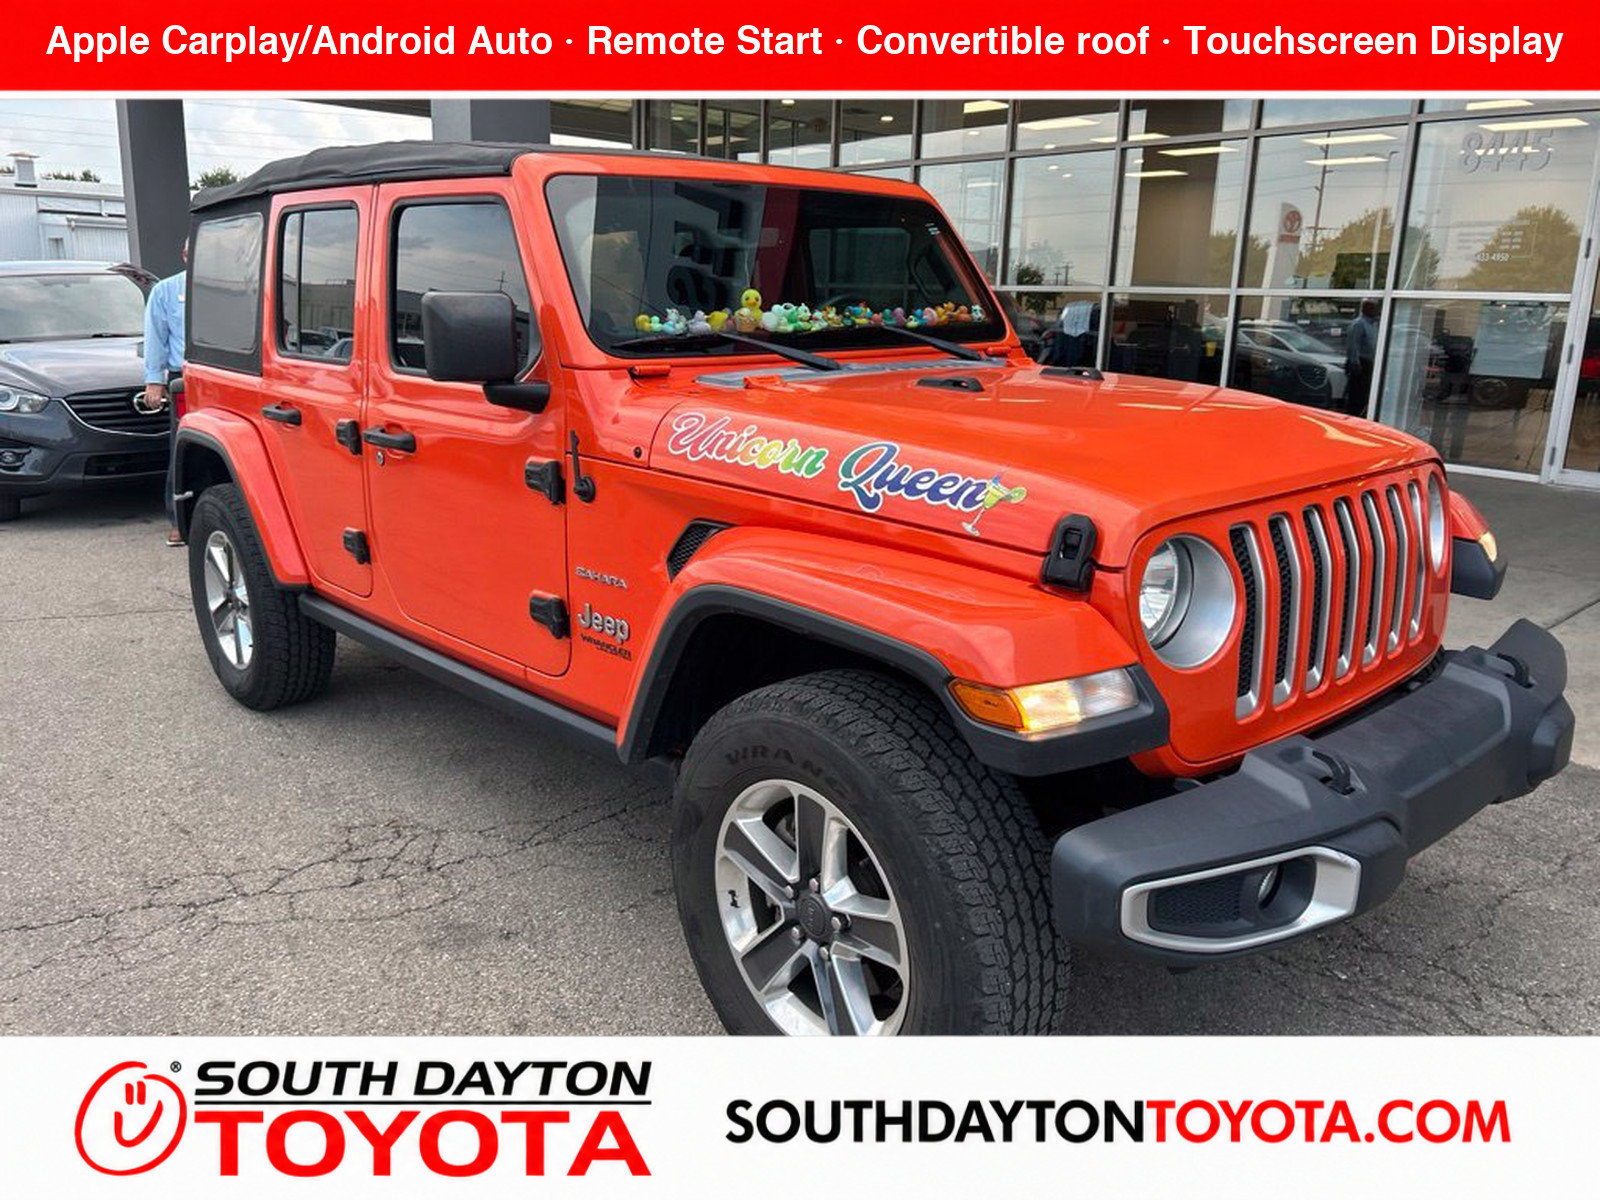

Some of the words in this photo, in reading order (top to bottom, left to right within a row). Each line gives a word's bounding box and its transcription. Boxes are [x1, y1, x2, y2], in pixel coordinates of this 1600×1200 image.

[1463, 129, 1554, 173] 8445
[668, 412, 829, 479] Unicorn
[838, 440, 988, 513] Queen
[575, 566, 627, 589] SAHARA
[577, 602, 630, 645] Jeep
